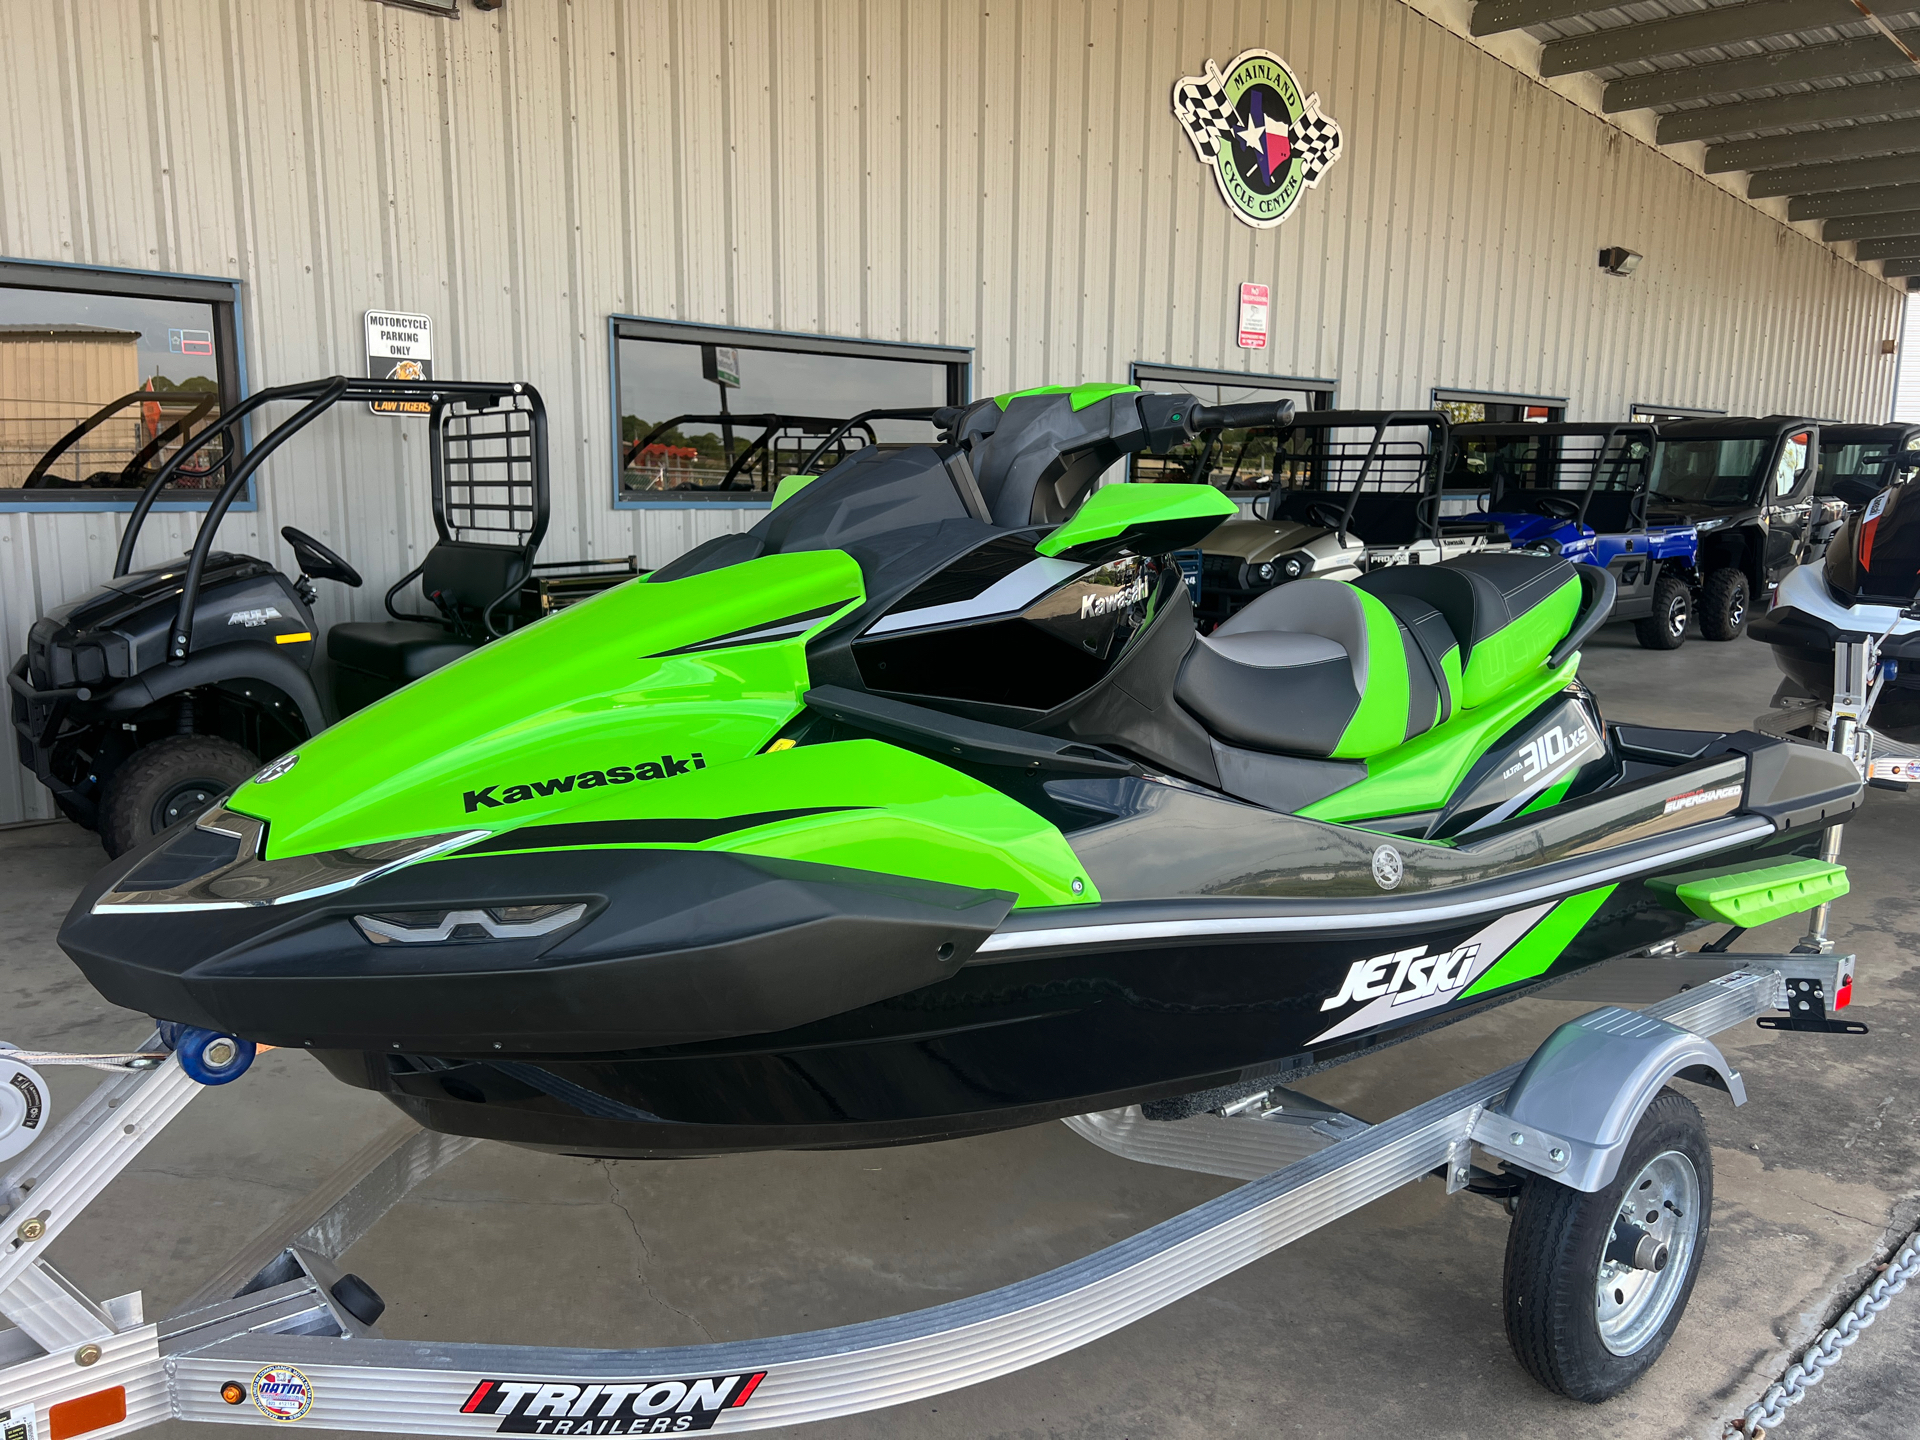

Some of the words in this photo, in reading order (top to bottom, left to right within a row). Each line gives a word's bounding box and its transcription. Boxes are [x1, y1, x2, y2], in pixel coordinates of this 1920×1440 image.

[1233, 64, 1296, 107] MAINLAND
[1223, 160, 1255, 209] CYCLE
[1258, 174, 1298, 213] CENTER
[370, 316, 428, 330] MOTORCYCLE
[380, 331, 419, 343] PARKING
[390, 345, 411, 356] ONLY
[374, 401, 398, 411] LAW
[399, 402, 431, 412] TIGERS
[1080, 574, 1149, 620] Kawasaki
[227, 607, 283, 626] MULE
[1502, 762, 1524, 780] ULTRA
[463, 752, 707, 814] Kawasaki
[1663, 784, 1743, 815] SUPERCHARGED
[258, 1365, 293, 1378] COMPLIANCE
[494, 1375, 742, 1417] TRITON
[534, 1415, 694, 1435] TRAILERS
